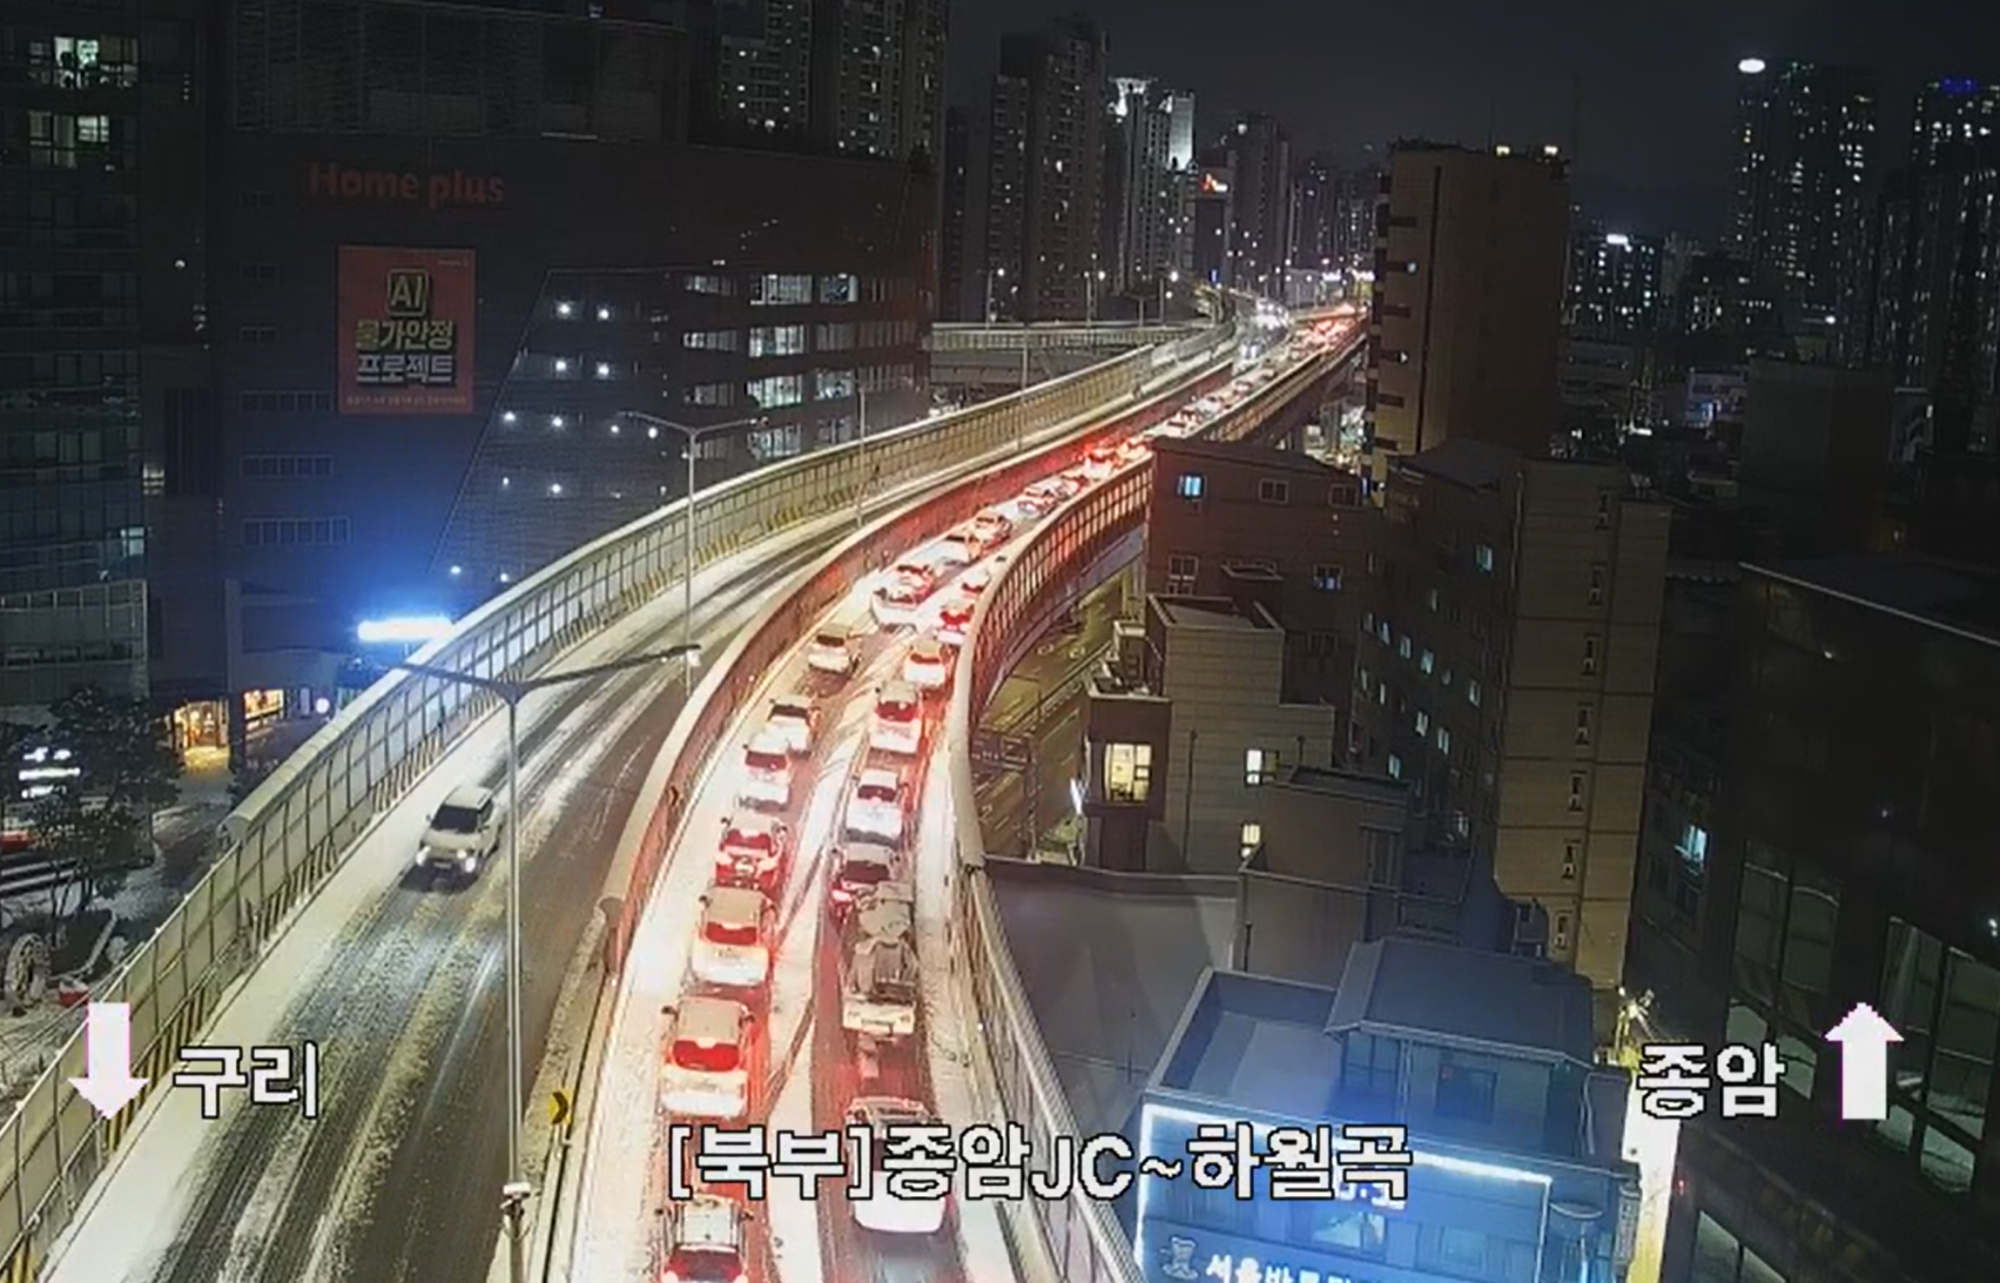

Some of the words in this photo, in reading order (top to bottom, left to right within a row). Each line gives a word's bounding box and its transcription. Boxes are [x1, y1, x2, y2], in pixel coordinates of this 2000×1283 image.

[308, 162, 420, 199] Home
[427, 168, 505, 209] plus
[390, 274, 423, 308] AI
[356, 354, 454, 384] 프로젝트
